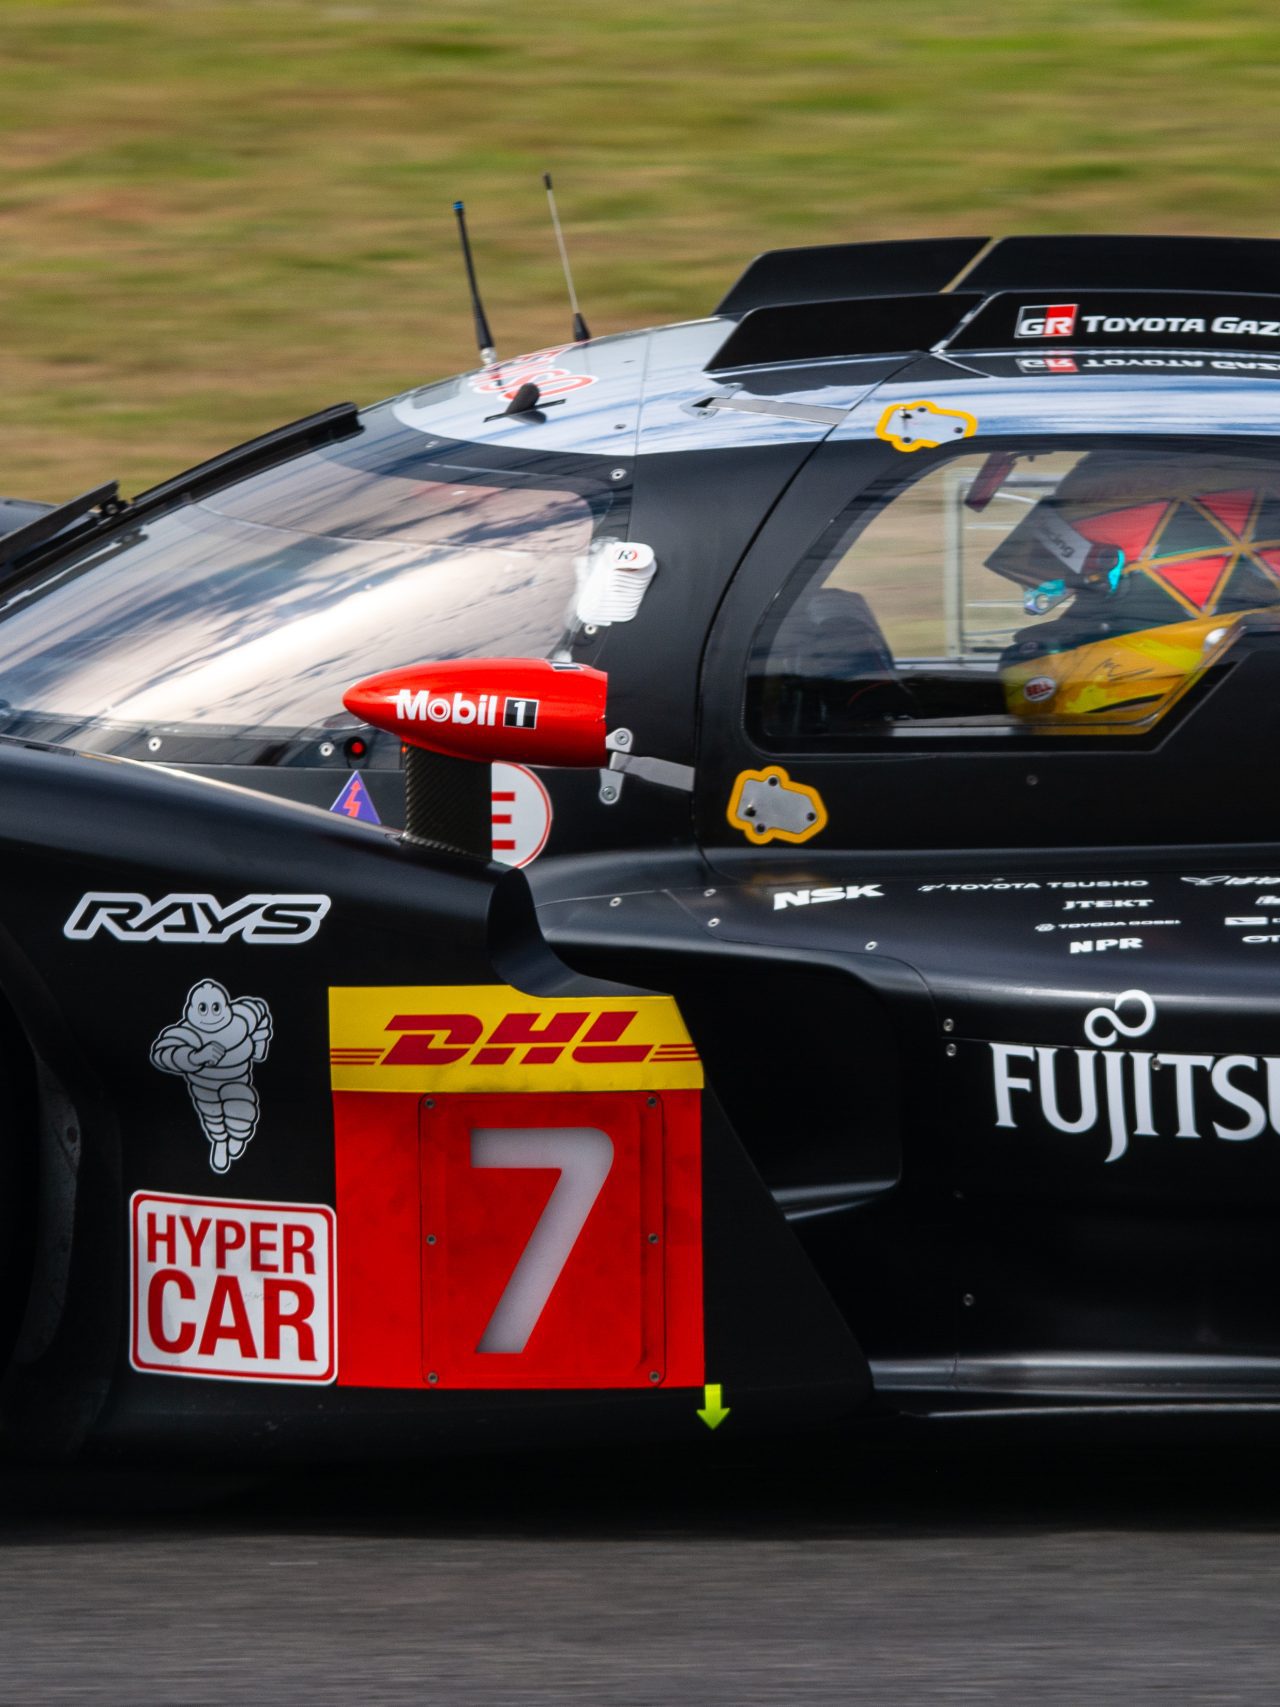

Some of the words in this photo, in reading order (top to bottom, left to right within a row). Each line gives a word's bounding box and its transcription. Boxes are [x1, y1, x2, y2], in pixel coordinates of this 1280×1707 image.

[1019, 316, 1075, 337] GR
[1082, 315, 1206, 335] TOYOTA
[396, 689, 498, 726] Mobil
[513, 700, 526, 727] 1
[773, 884, 885, 911] NSK
[946, 882, 1041, 891] TOYOTA
[1046, 880, 1149, 889] TSUSHO
[63, 891, 331, 943] RAYS
[1063, 899, 1154, 910] JTEKT
[1058, 920, 1127, 929] TOYODA
[1069, 937, 1143, 954] NPR
[380, 1010, 654, 1066] DHL
[146, 1212, 317, 1276] HYPER
[470, 1127, 615, 1354] 7
[147, 1268, 318, 1362] CAR
